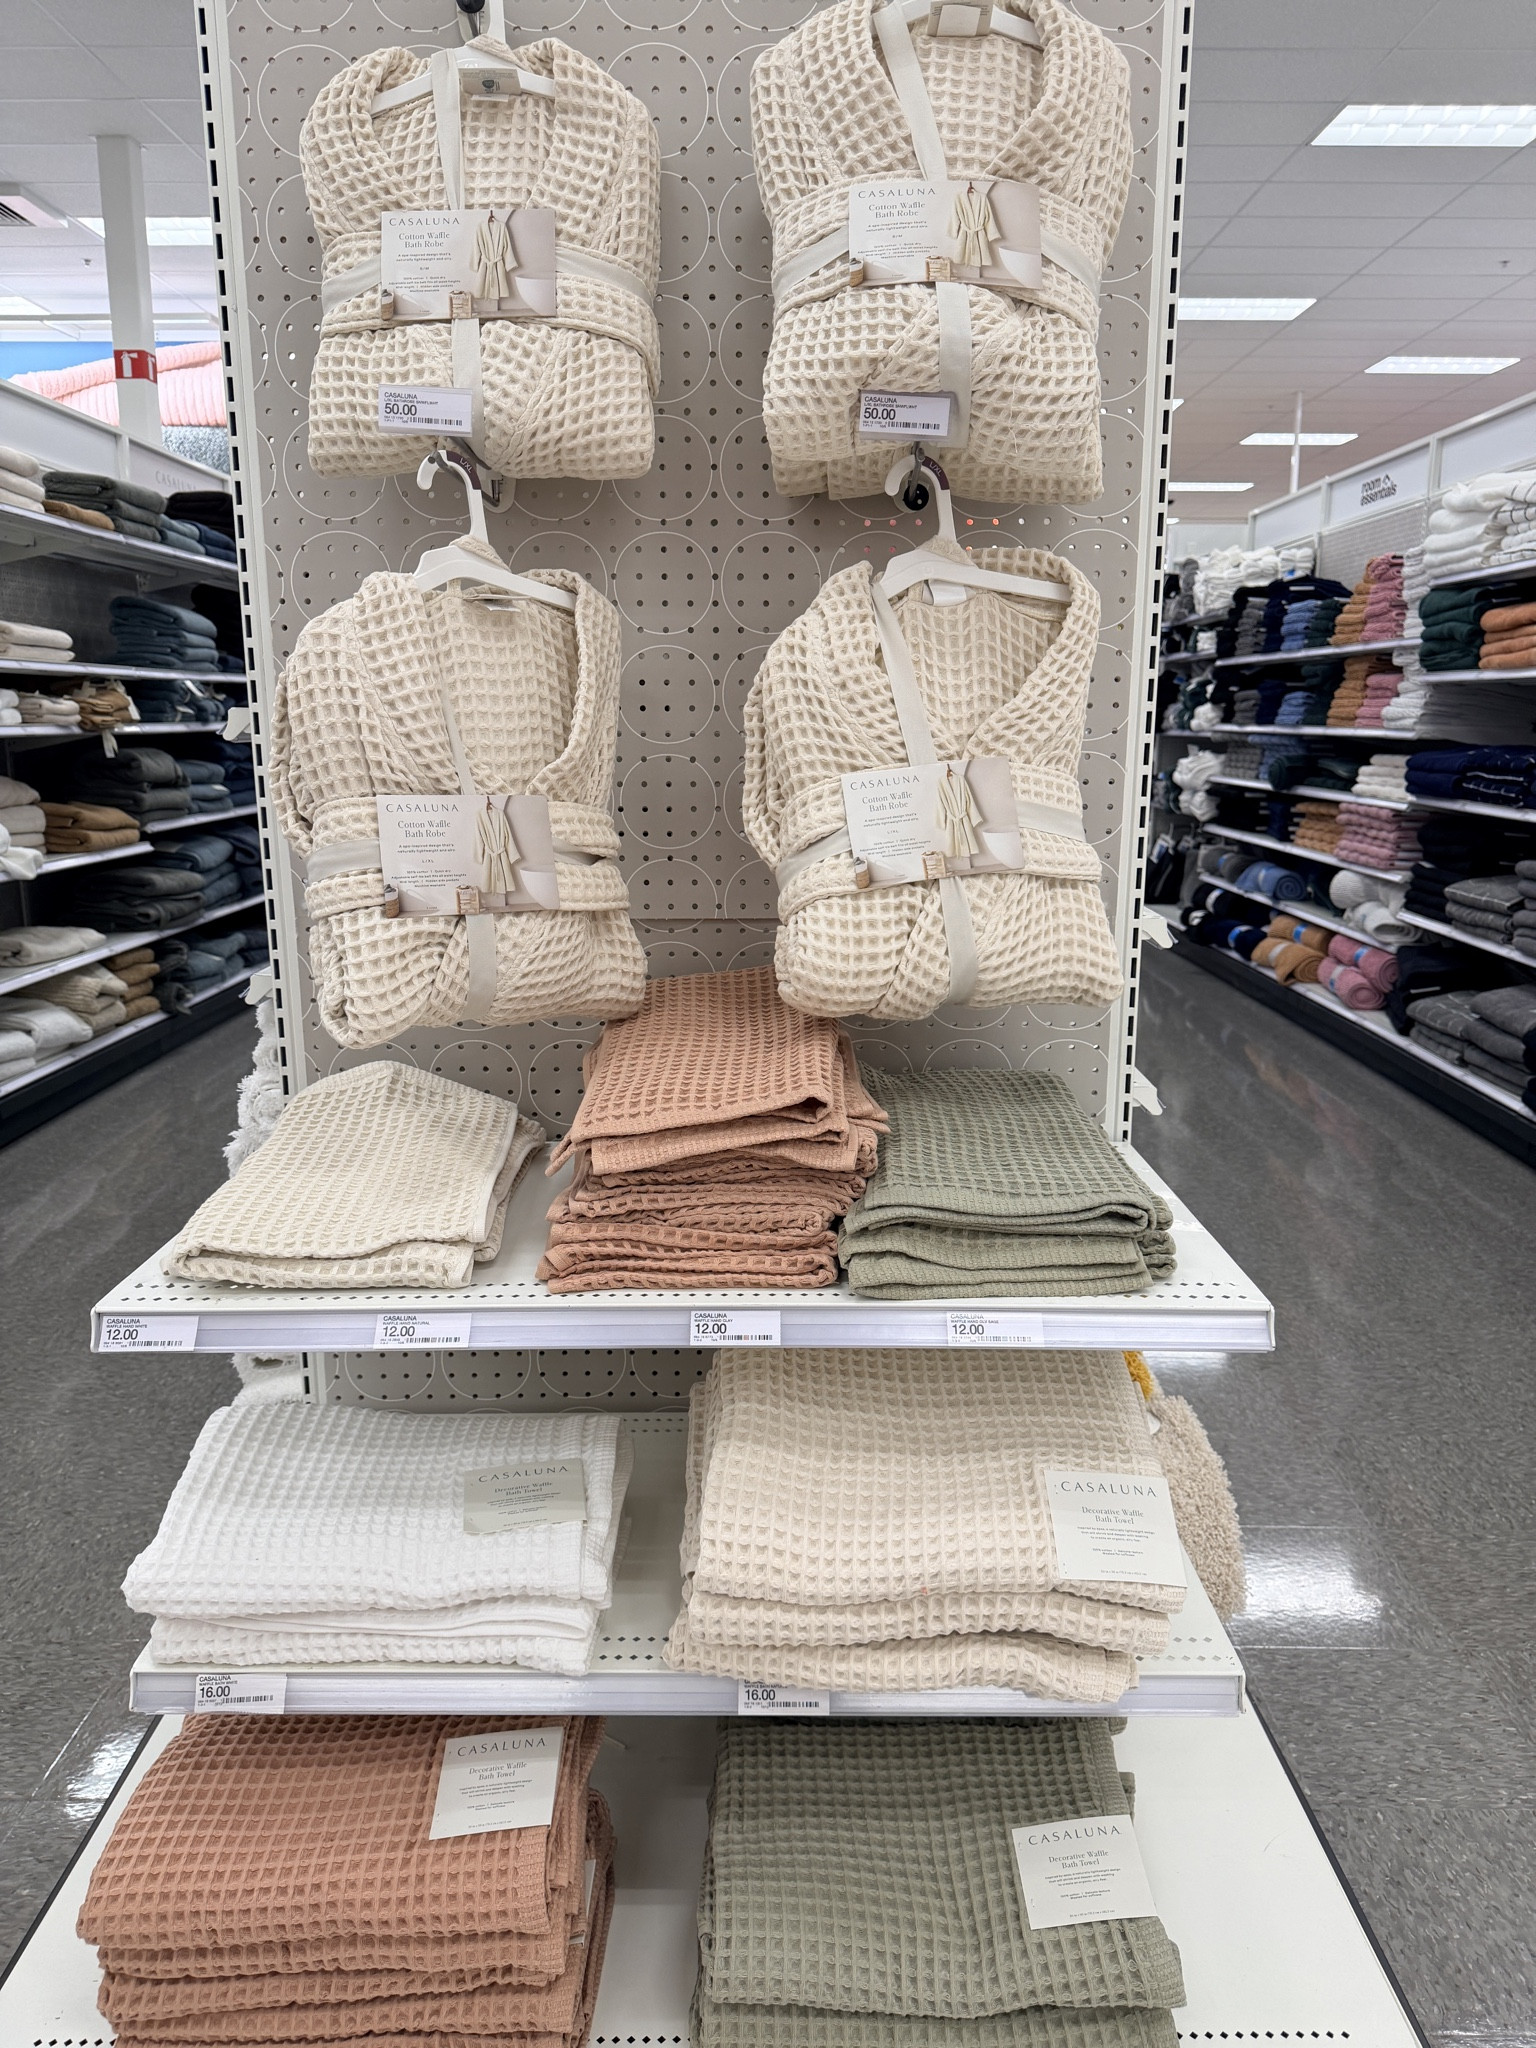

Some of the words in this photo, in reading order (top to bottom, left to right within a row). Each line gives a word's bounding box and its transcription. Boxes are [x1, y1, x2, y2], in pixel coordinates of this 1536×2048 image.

[858, 188, 936, 198] CASALUNA
[868, 203, 897, 212] Cotton
[900, 202, 926, 210] Waffle
[876, 210, 894, 219] Bath
[390, 217, 460, 226] CASALUNA
[398, 232, 424, 240] Cotton
[428, 232, 450, 240] Waffle
[404, 240, 422, 248] Bath
[424, 240, 444, 248] Robe
[385, 403, 417, 416] 50.00
[864, 408, 896, 420] 50.00
[460, 457, 472, 473] L/XL
[930, 461, 941, 476] L/XL
[850, 775, 920, 790] CASALUNA
[862, 795, 888, 805] Cotton
[890, 792, 912, 800] Waffle
[386, 804, 459, 812] CASALUNA
[869, 803, 887, 812] Bath
[888, 801, 908, 810] Robe
[398, 820, 425, 829] Cotton
[405, 830, 423, 838] Bath
[383, 1326, 415, 1337] 12.00
[695, 1323, 727, 1334] 12.00
[952, 1324, 984, 1335] 12.00
[106, 1329, 138, 1340] 12.00
[478, 1466, 568, 1482] CASALUNA
[1061, 1481, 1157, 1498] CASALUNA
[1082, 1506, 1120, 1516] Decorative
[1121, 1509, 1144, 1517] Waffle
[1095, 1515, 1112, 1523] Bath
[1114, 1516, 1134, 1524] Towel
[200, 1686, 230, 1698] 16.00
[745, 1689, 775, 1700] 16.00
[457, 1737, 546, 1756] CASALUNA
[469, 1766, 504, 1774] Decorative
[496, 1770, 516, 1779] Towel
[1028, 1825, 1120, 1846] CASALUNA
[1049, 1854, 1085, 1863] Decorative
[1087, 1850, 1109, 1858] Waffle
[1079, 1858, 1100, 1867] Towel
